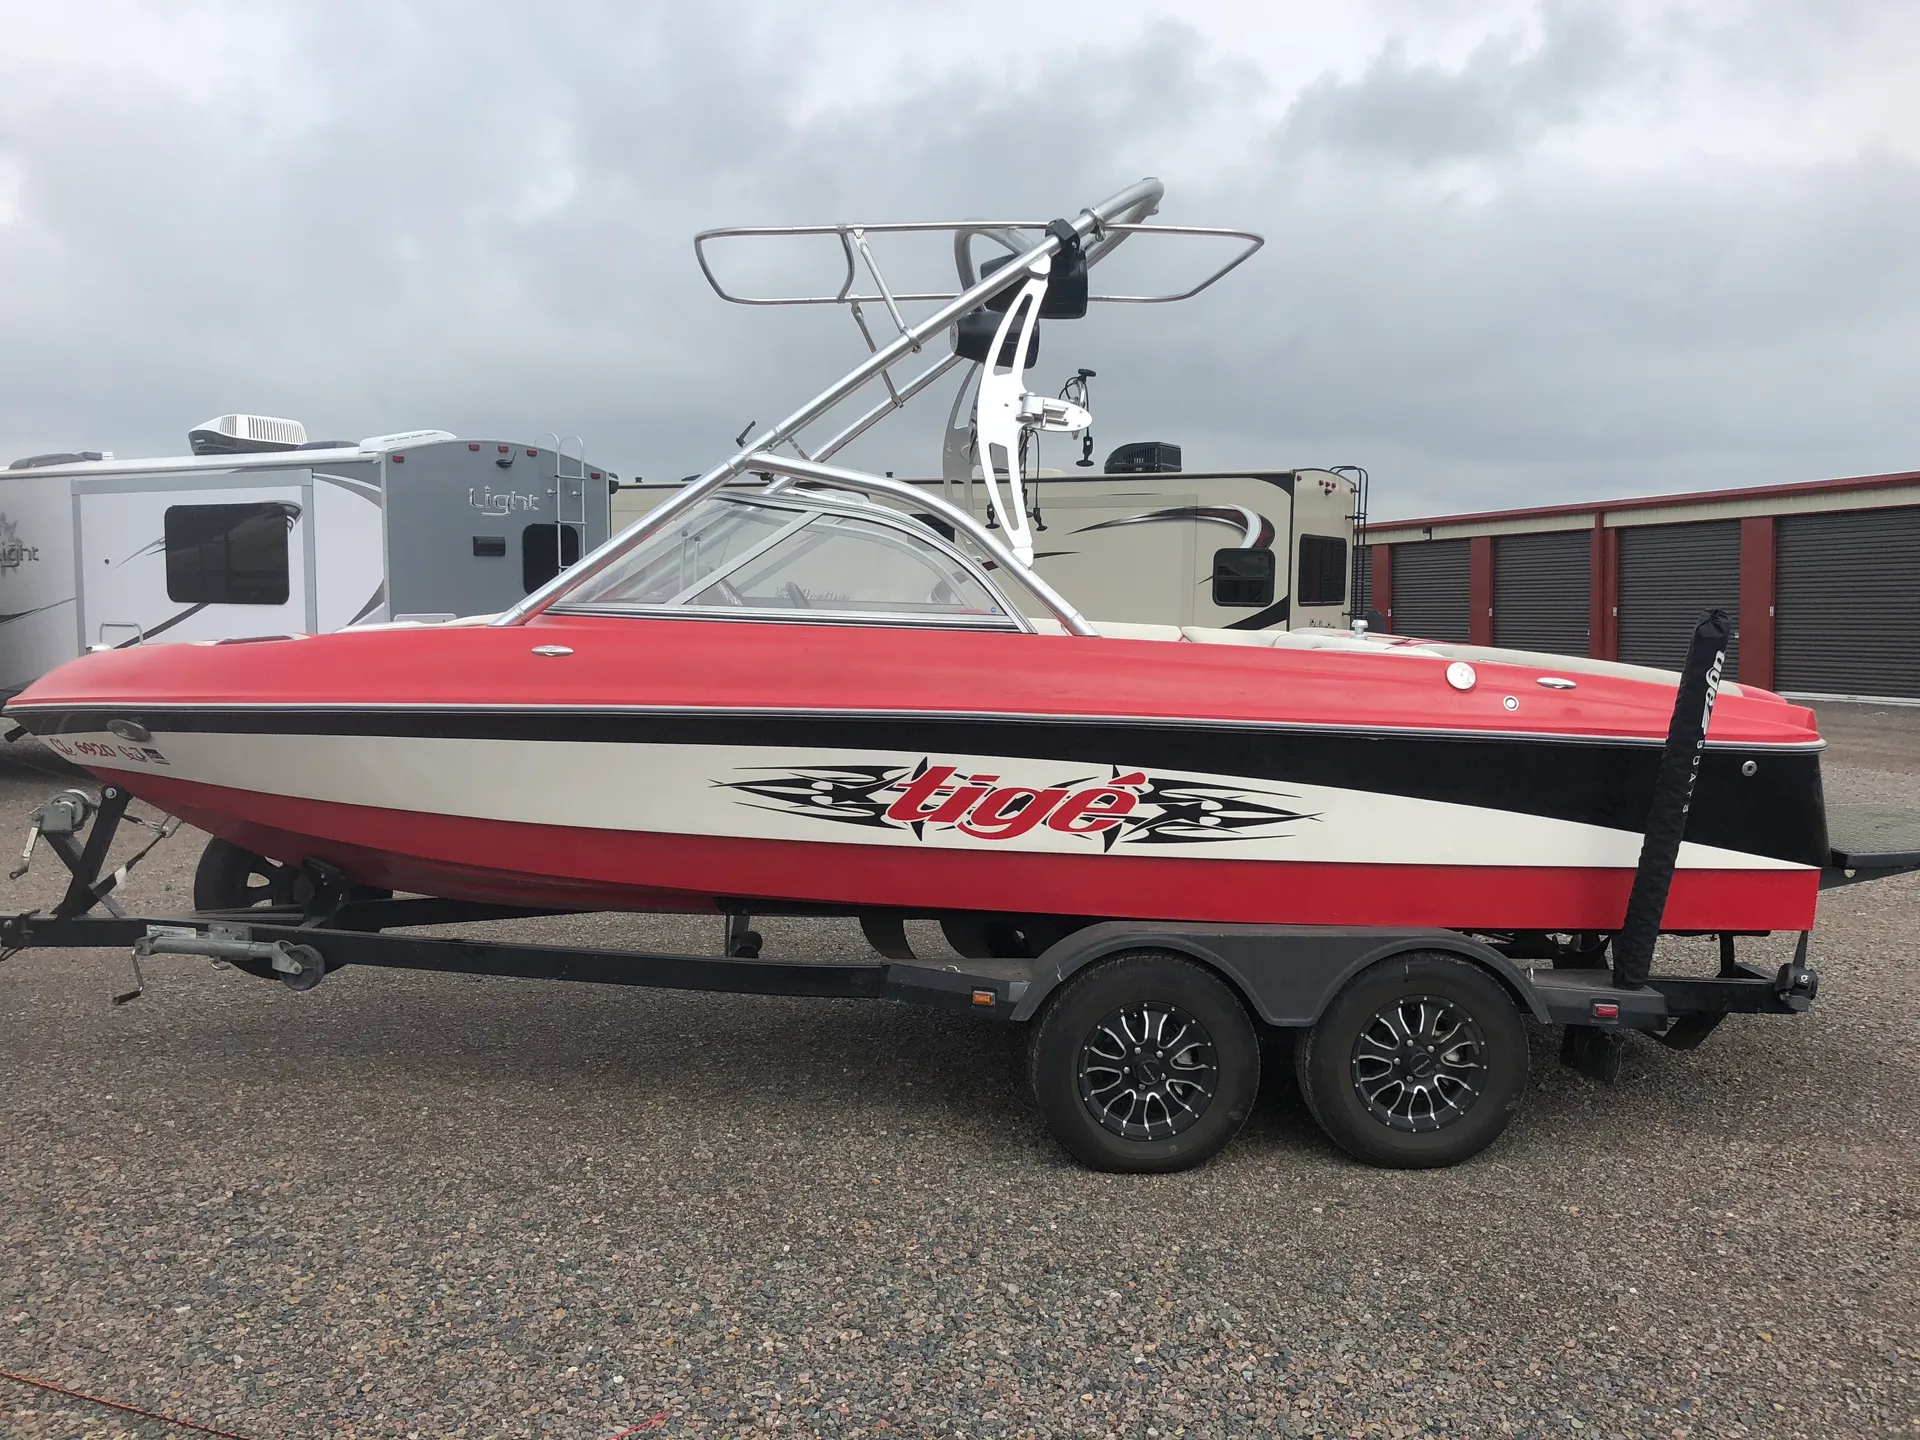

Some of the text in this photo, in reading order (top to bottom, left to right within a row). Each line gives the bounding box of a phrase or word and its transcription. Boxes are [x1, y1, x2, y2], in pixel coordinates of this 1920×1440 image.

[468, 485, 539, 517] Light
[0, 541, 40, 569] ight
[74, 741, 117, 758] 6920
[886, 765, 1147, 840] tigé
